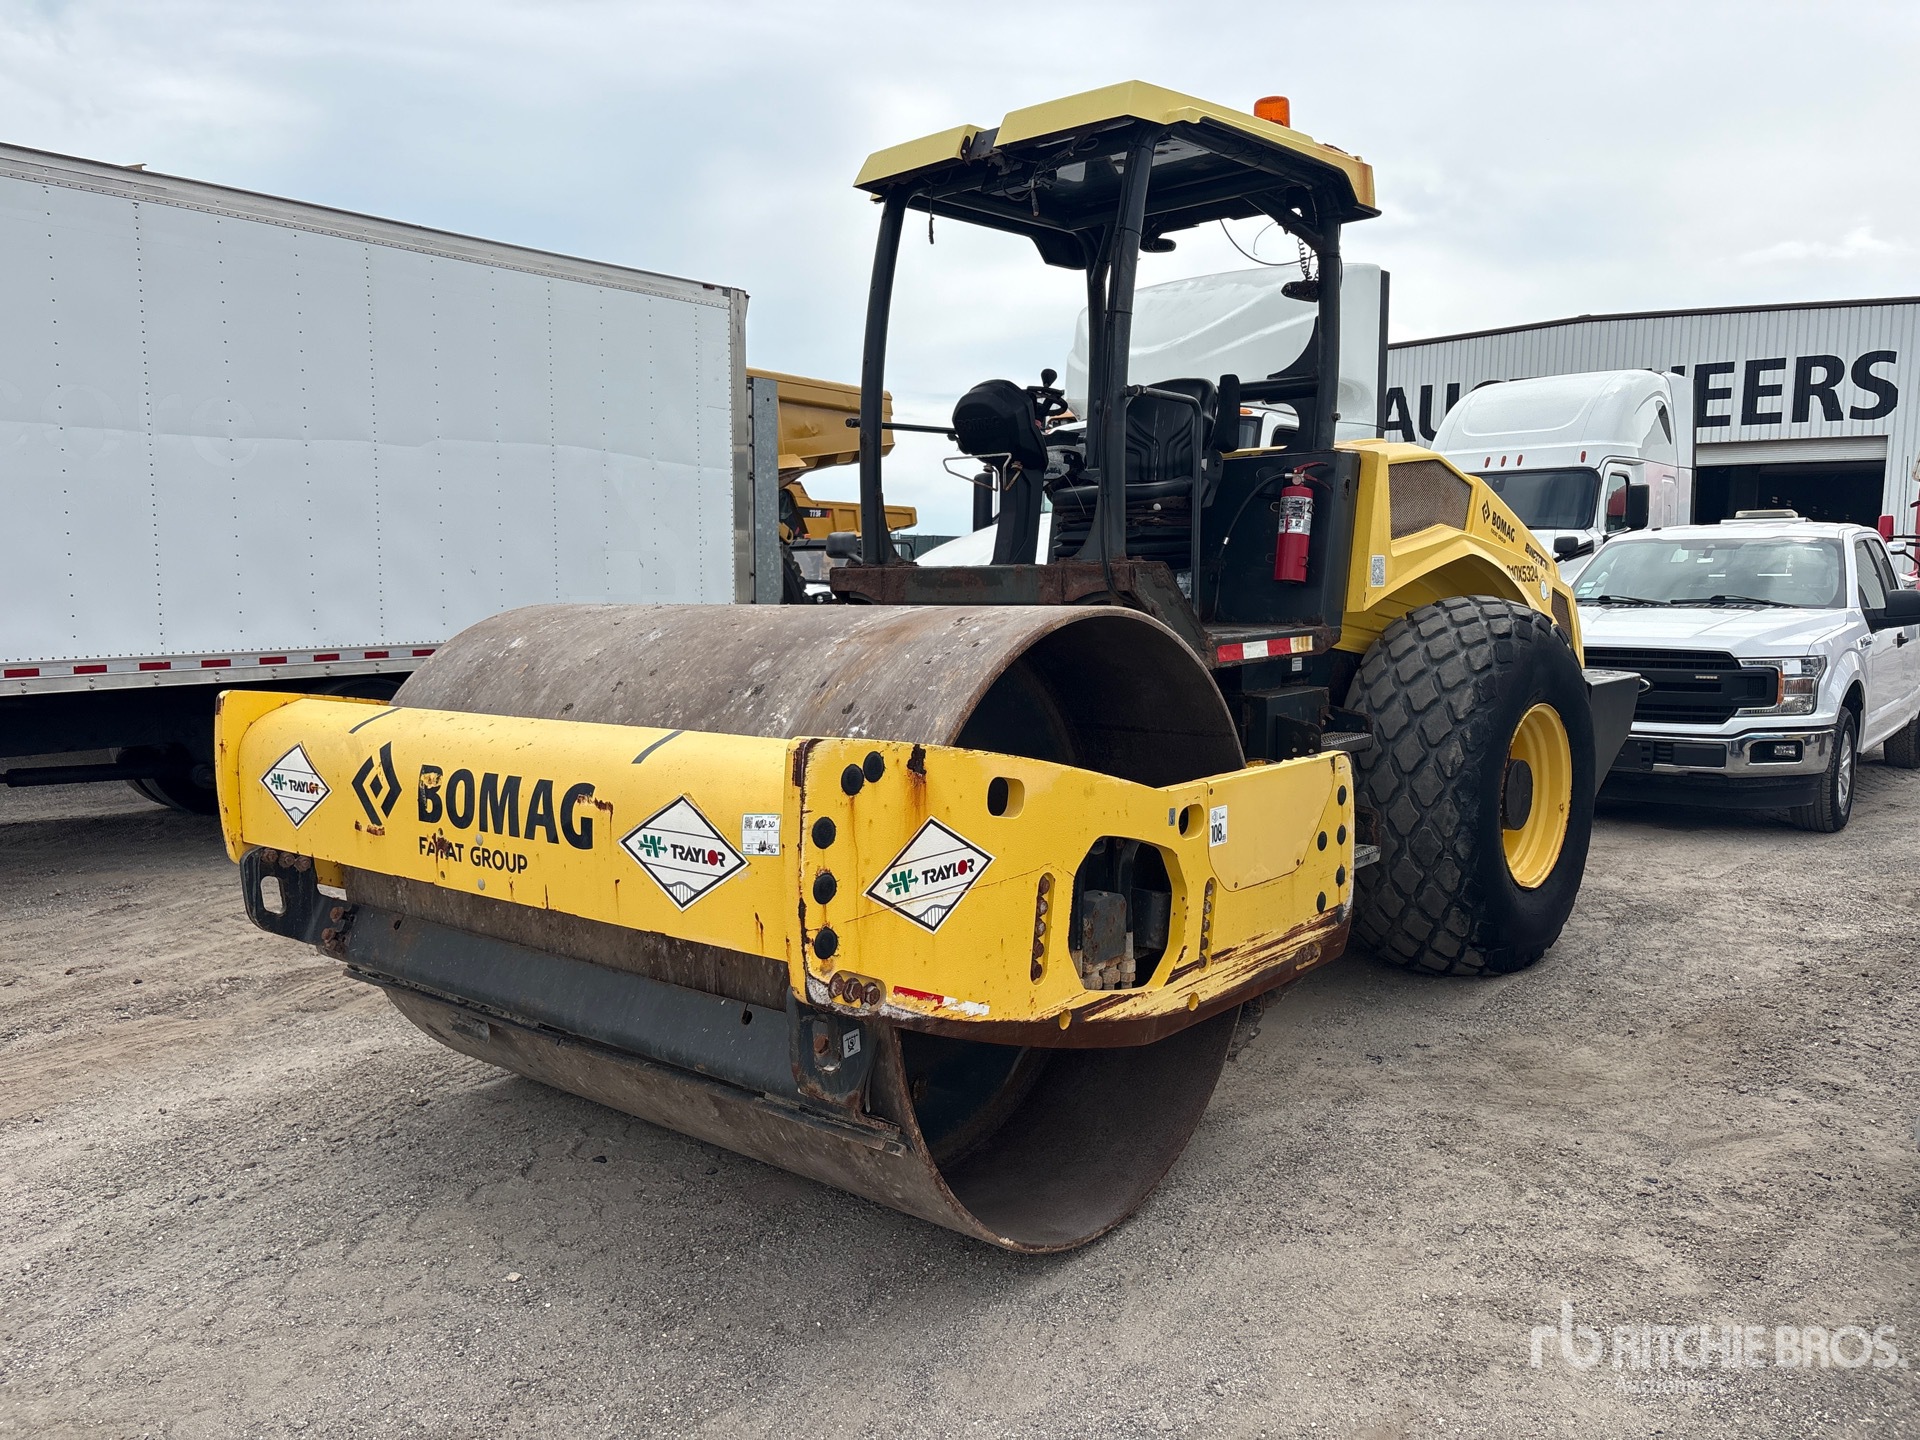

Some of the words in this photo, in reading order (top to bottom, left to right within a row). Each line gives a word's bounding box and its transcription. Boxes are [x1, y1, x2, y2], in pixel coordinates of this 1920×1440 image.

[1491, 511, 1516, 543] BOMAG
[418, 764, 596, 851] BOMAG
[1211, 823, 1223, 844] 108
[470, 846, 528, 874] GROUP
[670, 843, 726, 867] TRAYLOR
[921, 858, 975, 885] TRAYLOR
